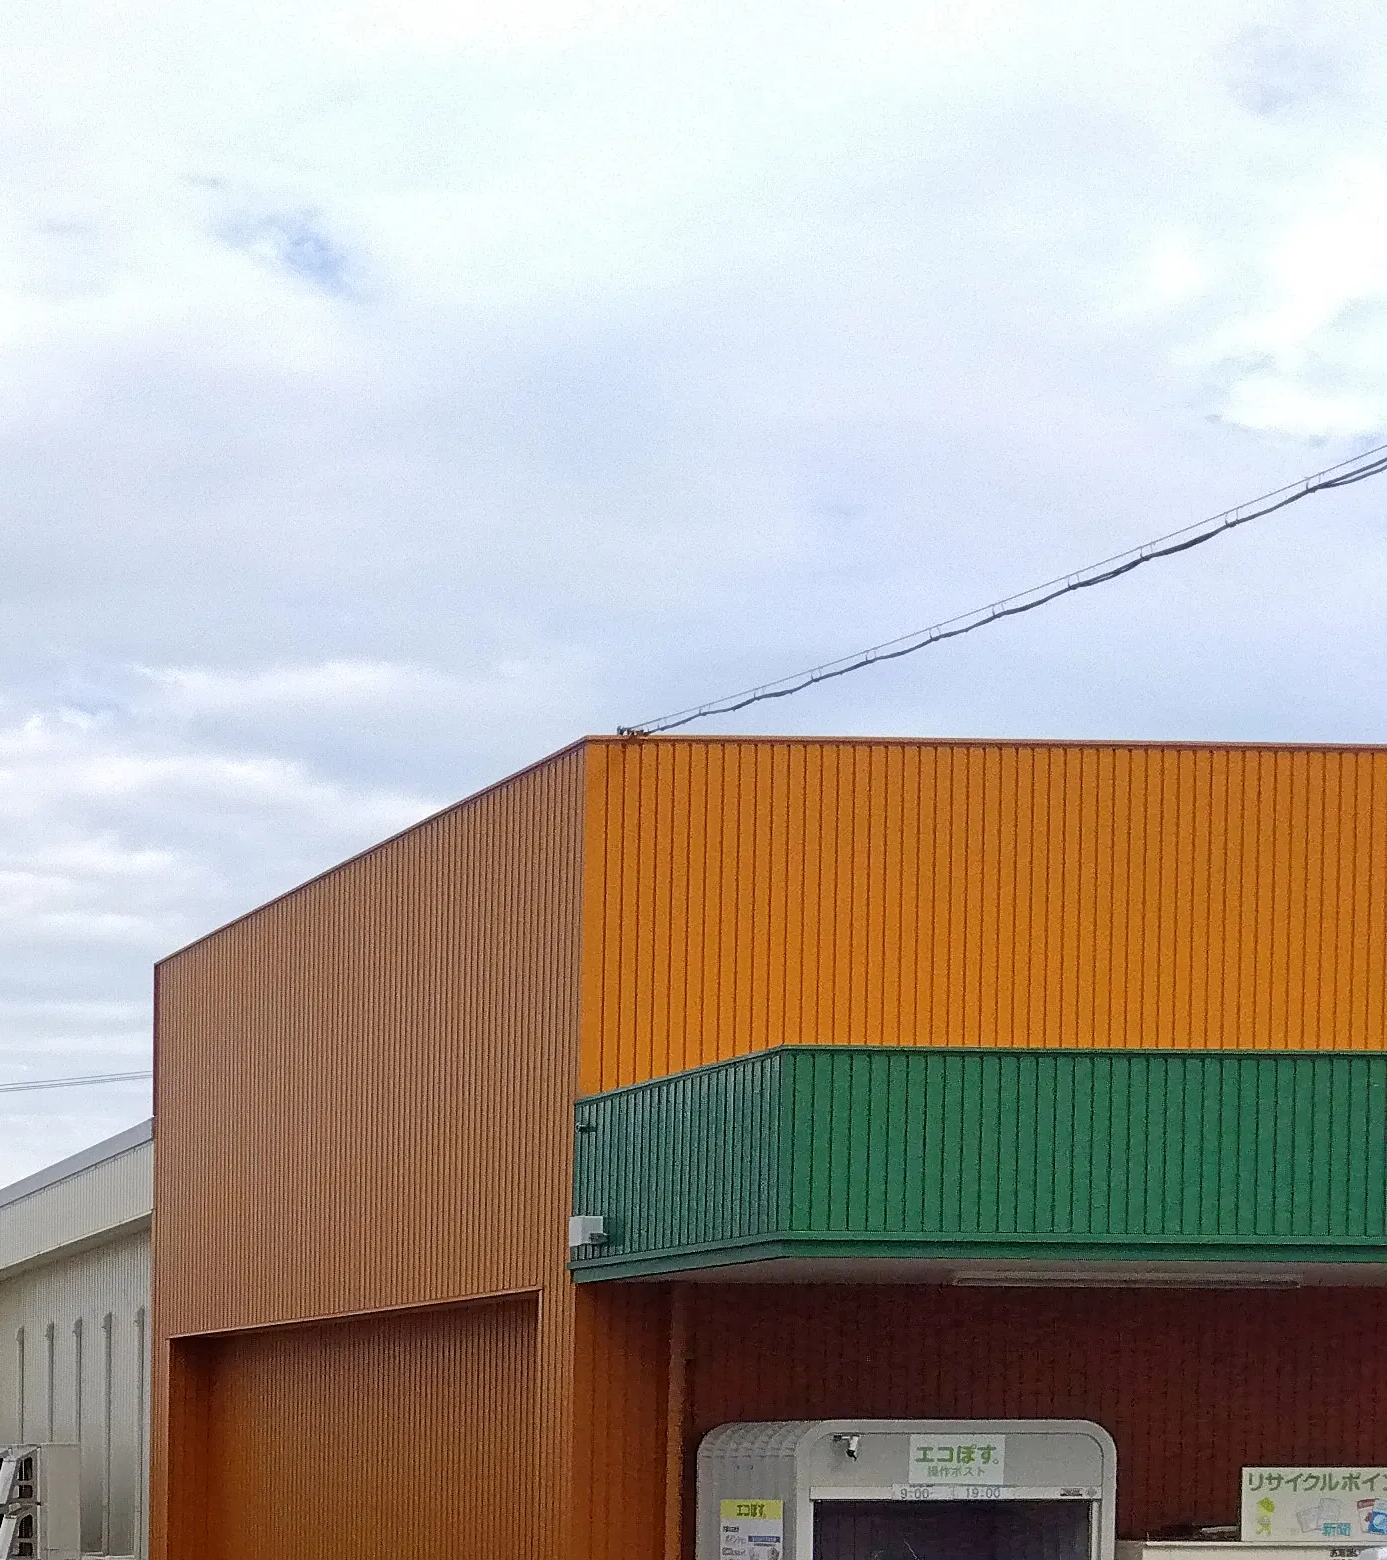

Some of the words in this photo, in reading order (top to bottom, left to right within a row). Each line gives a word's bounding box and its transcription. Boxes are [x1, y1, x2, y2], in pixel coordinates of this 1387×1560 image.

[914, 1443, 1000, 1465] エコぽす。
[1248, 1472, 1387, 1493] リサイクルポイ
[1322, 1522, 1352, 1537] 新聞
